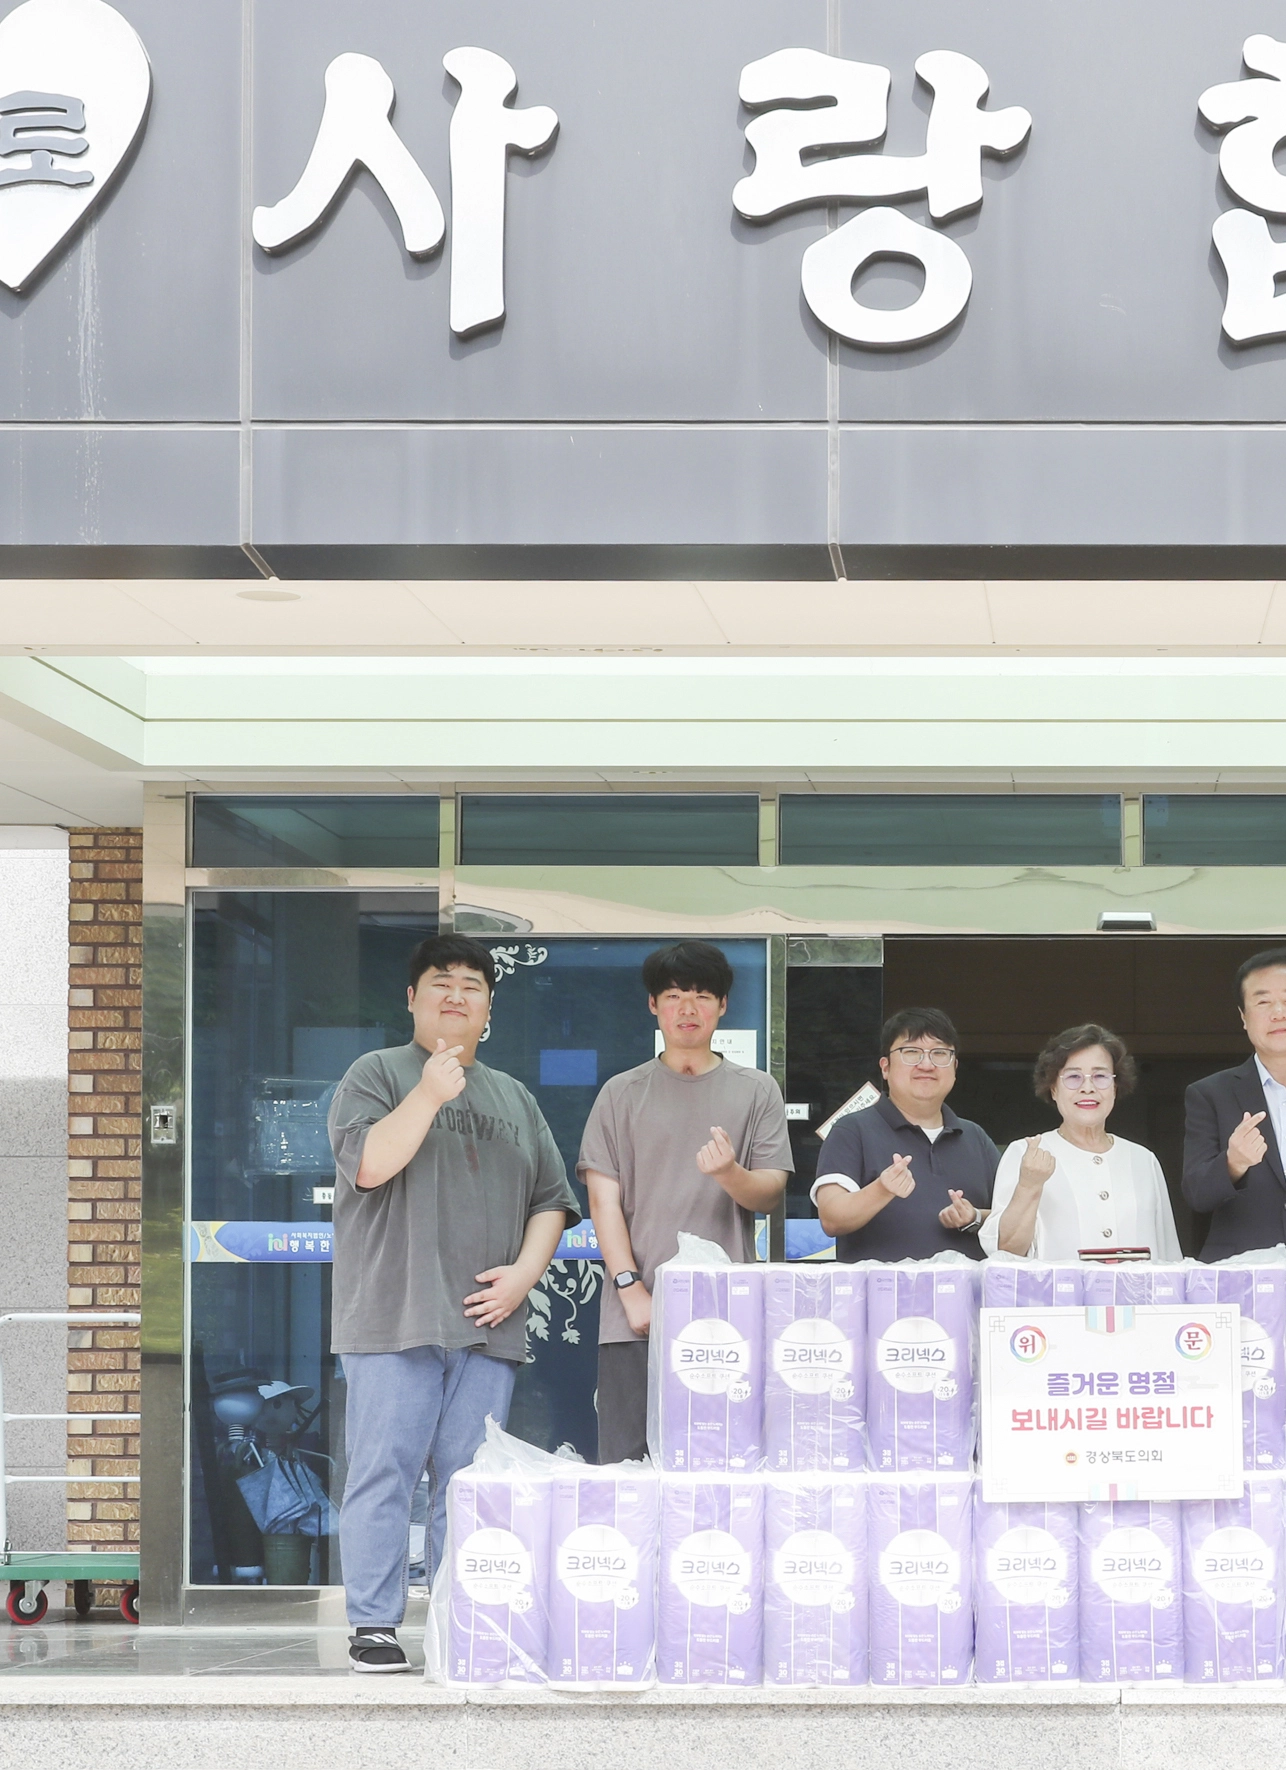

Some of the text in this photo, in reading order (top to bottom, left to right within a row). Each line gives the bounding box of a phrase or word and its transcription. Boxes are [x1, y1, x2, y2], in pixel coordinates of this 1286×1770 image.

[1019, 1332, 1203, 1354] 위 문
[680, 1348, 740, 1364] 크리넥스
[782, 1348, 843, 1364] 크리넥스
[885, 1346, 946, 1364] 크리넥스
[1047, 1371, 1175, 1396] 즐거운 명절
[1012, 1406, 1214, 1431] 보내시길 바랍니다
[1086, 1450, 1162, 1464] 경상북도의회
[464, 1558, 521, 1576] 크리넥스
[566, 1556, 627, 1572] 크리넥스
[681, 1560, 741, 1576] 크리넥스
[783, 1560, 843, 1576] 크리넥스
[889, 1560, 949, 1576] 크리넥스
[997, 1556, 1057, 1574] 크리넥스
[1102, 1556, 1162, 1574] 크리넥스
[1204, 1556, 1264, 1574] 크리넥스
